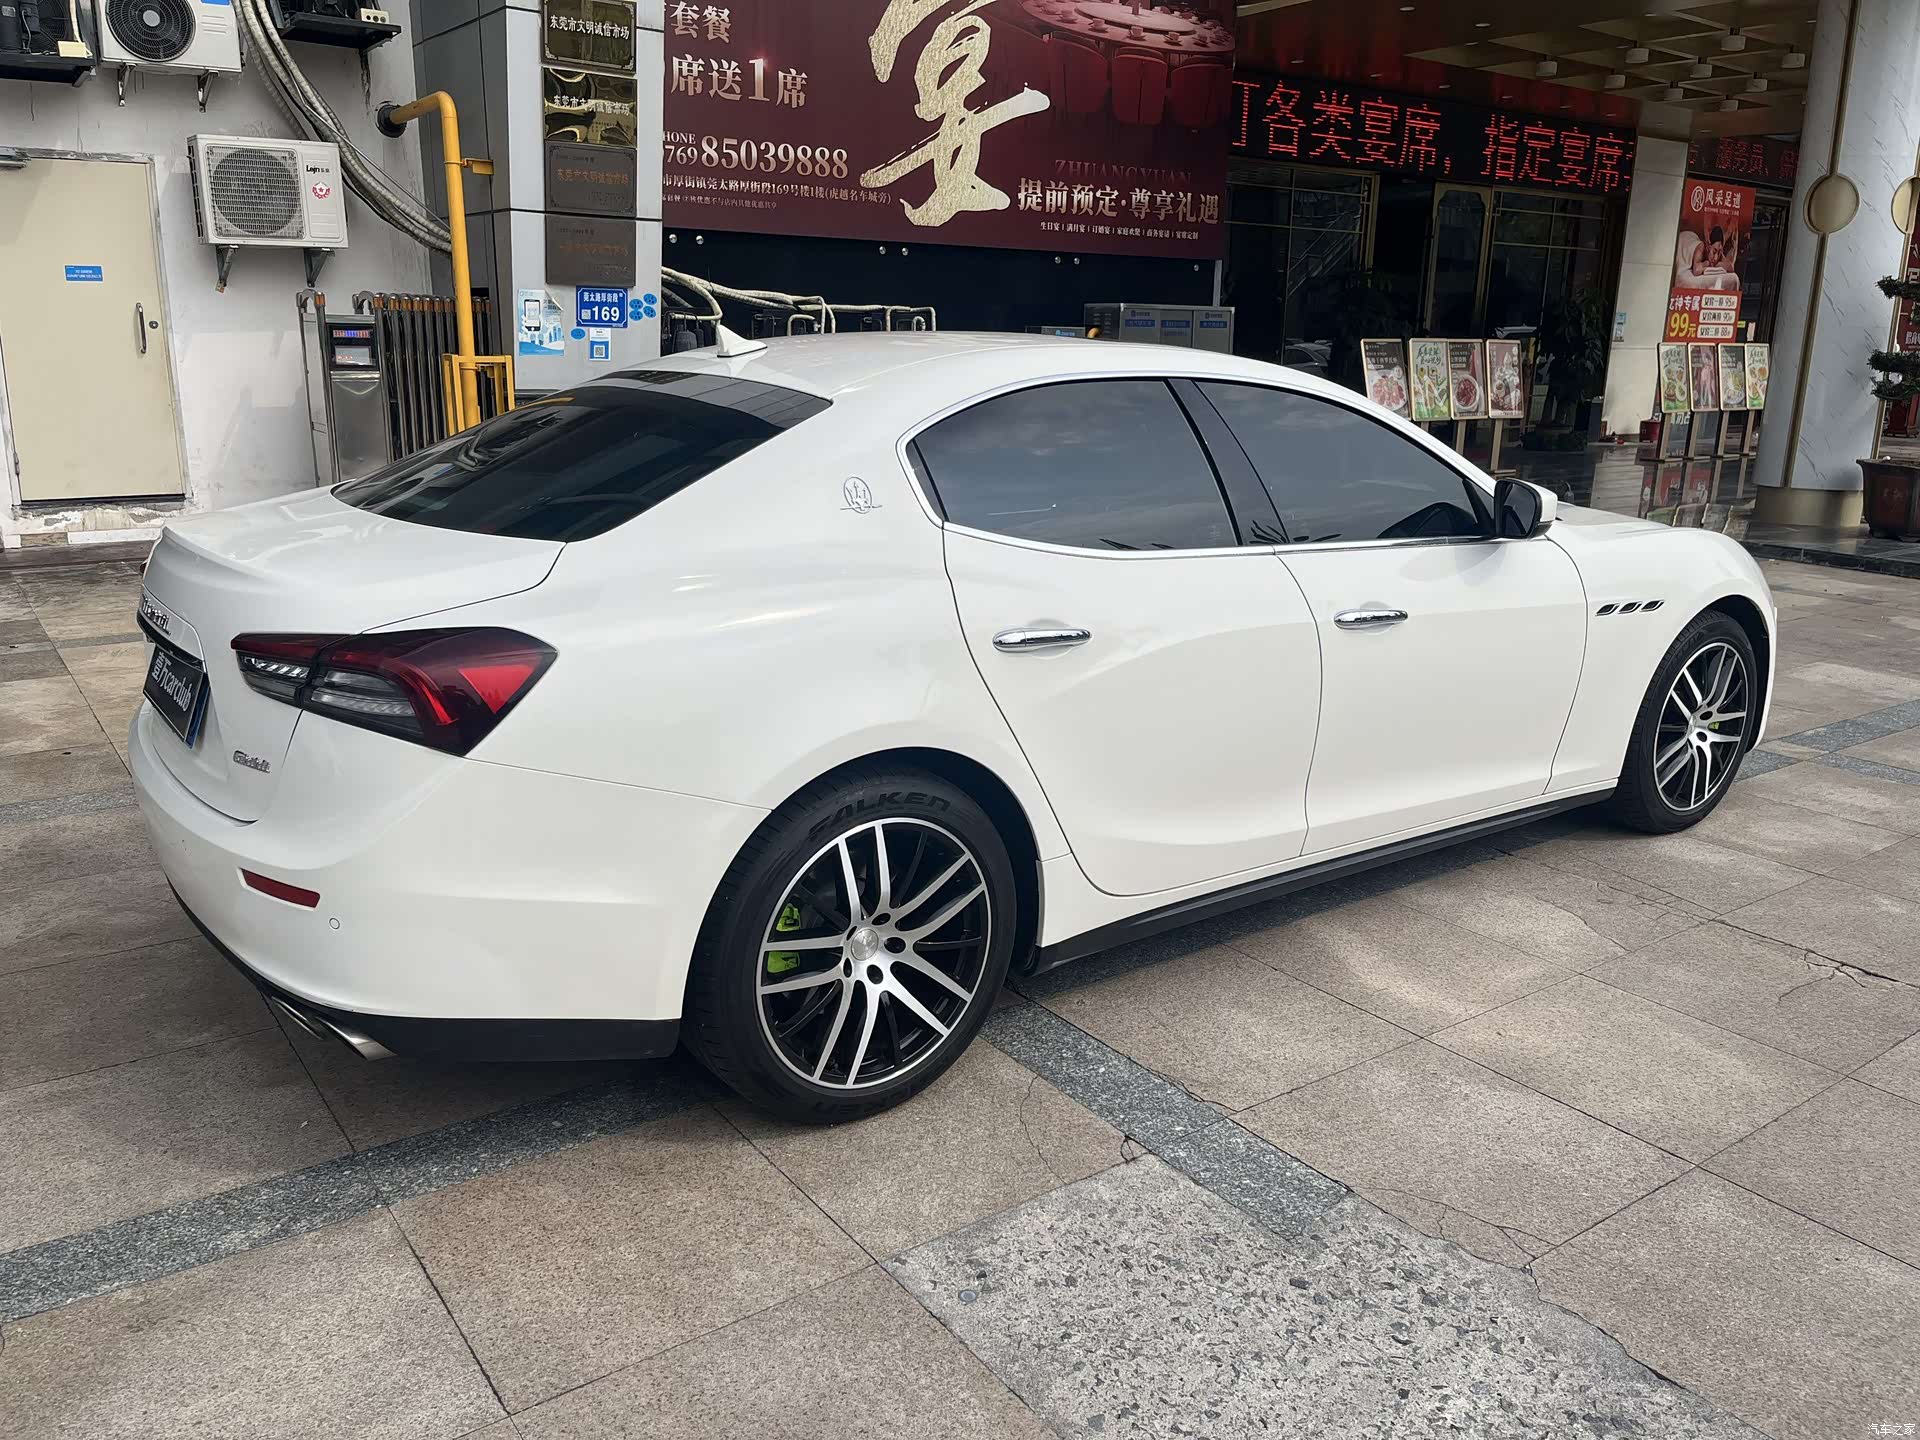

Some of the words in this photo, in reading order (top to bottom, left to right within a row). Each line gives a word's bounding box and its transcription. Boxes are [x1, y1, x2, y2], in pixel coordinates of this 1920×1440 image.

[549, 15, 630, 40] 东莞市文明诚信市场
[664, 1, 732, 43] 套餐
[670, 54, 808, 108] 席送1席
[663, 144, 698, 165] 769
[701, 135, 848, 179] 85039888
[1018, 177, 1219, 224] 提前预定·尊享礼遇
[592, 305, 620, 322] 169
